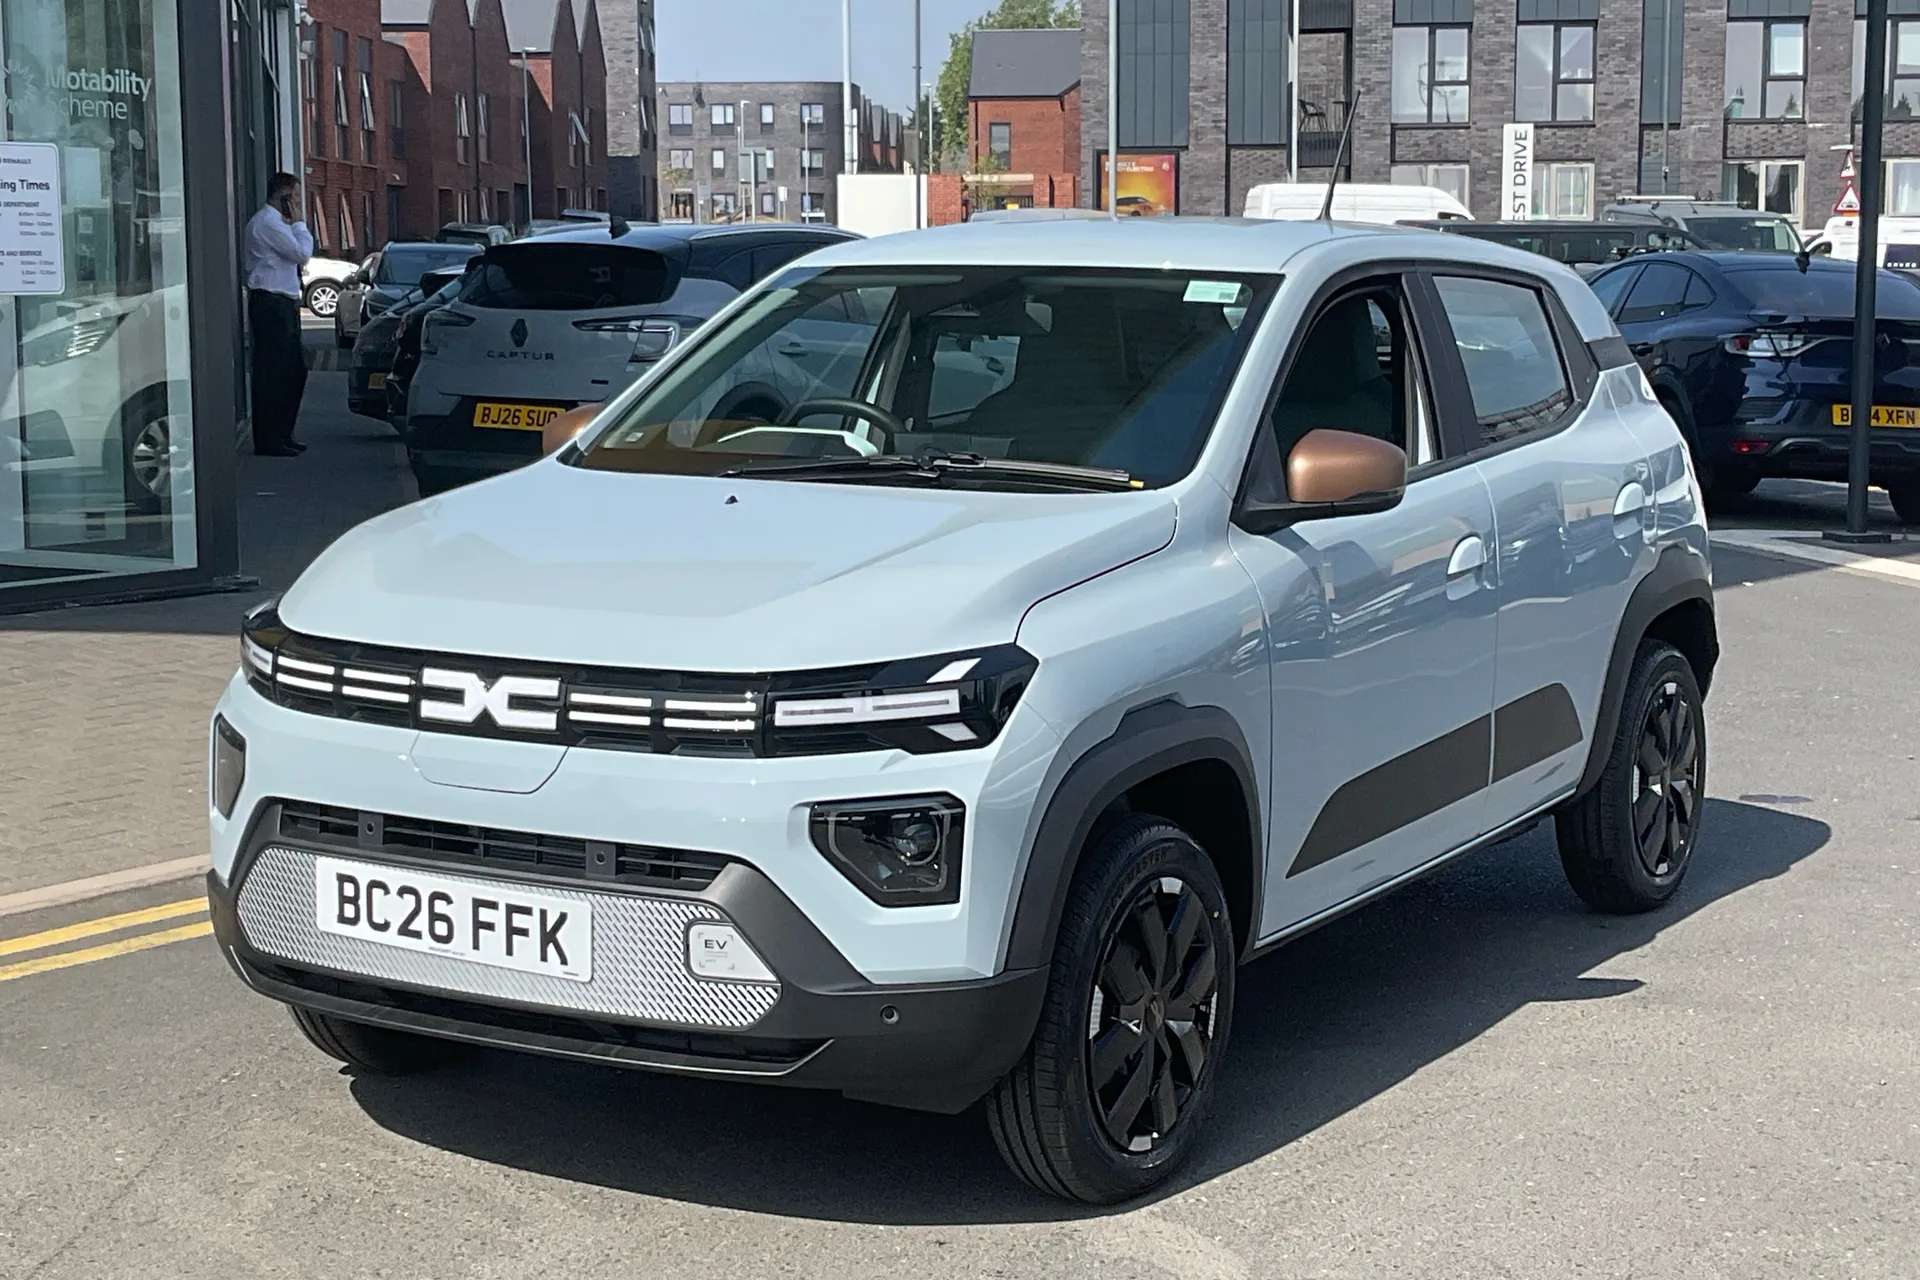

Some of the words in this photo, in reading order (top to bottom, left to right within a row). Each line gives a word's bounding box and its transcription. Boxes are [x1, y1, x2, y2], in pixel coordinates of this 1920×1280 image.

[46, 64, 152, 101] Motability
[48, 92, 127, 119] cheme
[1513, 130, 1527, 186] DRIVE
[19, 179, 50, 190] Times
[486, 350, 554, 361] CAPTUR
[480, 406, 521, 425] BJ26
[1885, 408, 1915, 425] XFN
[336, 872, 454, 945] BC26
[471, 897, 569, 967] FFK
[704, 939, 728, 950] EV
